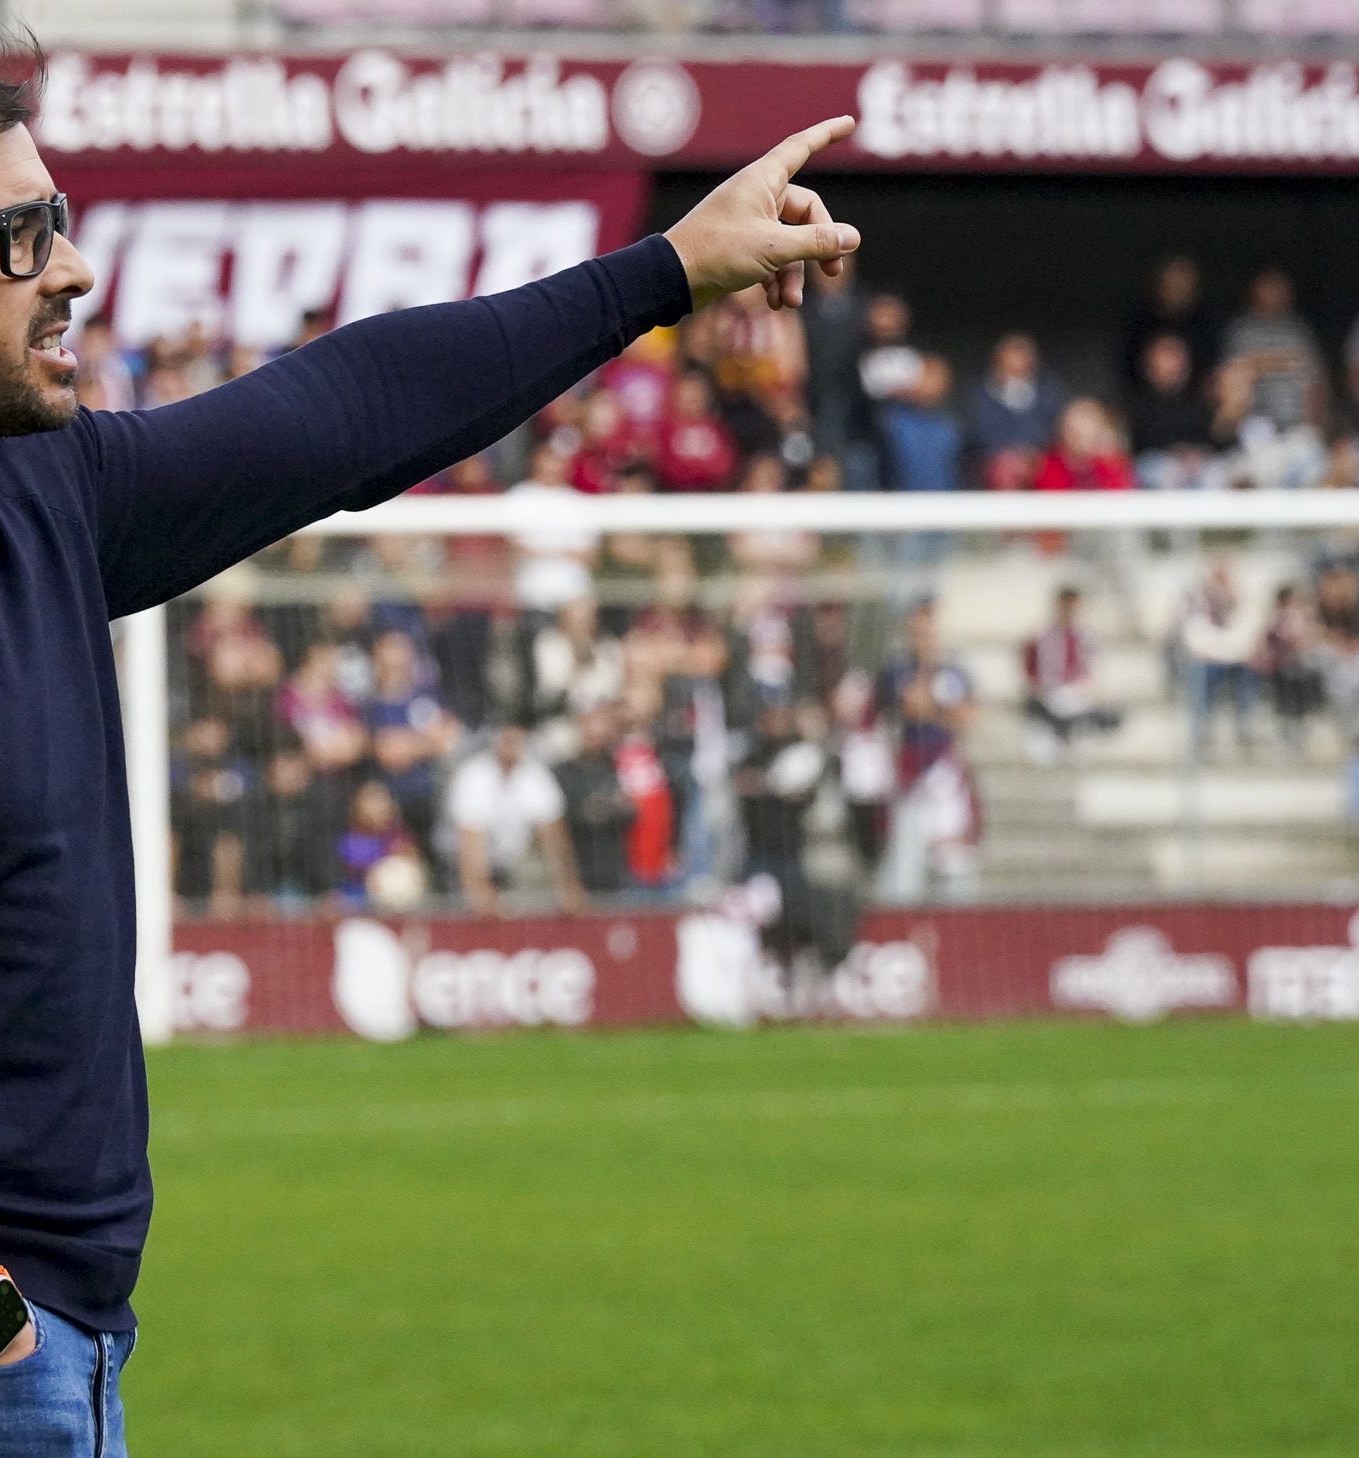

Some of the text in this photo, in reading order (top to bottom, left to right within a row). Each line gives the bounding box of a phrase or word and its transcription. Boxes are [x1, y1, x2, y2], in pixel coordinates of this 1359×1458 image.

[36, 48, 609, 153] Estrella Galicia
[855, 62, 1141, 159] Estrella
[170, 950, 251, 1030] ce
[411, 947, 595, 1028] ence
